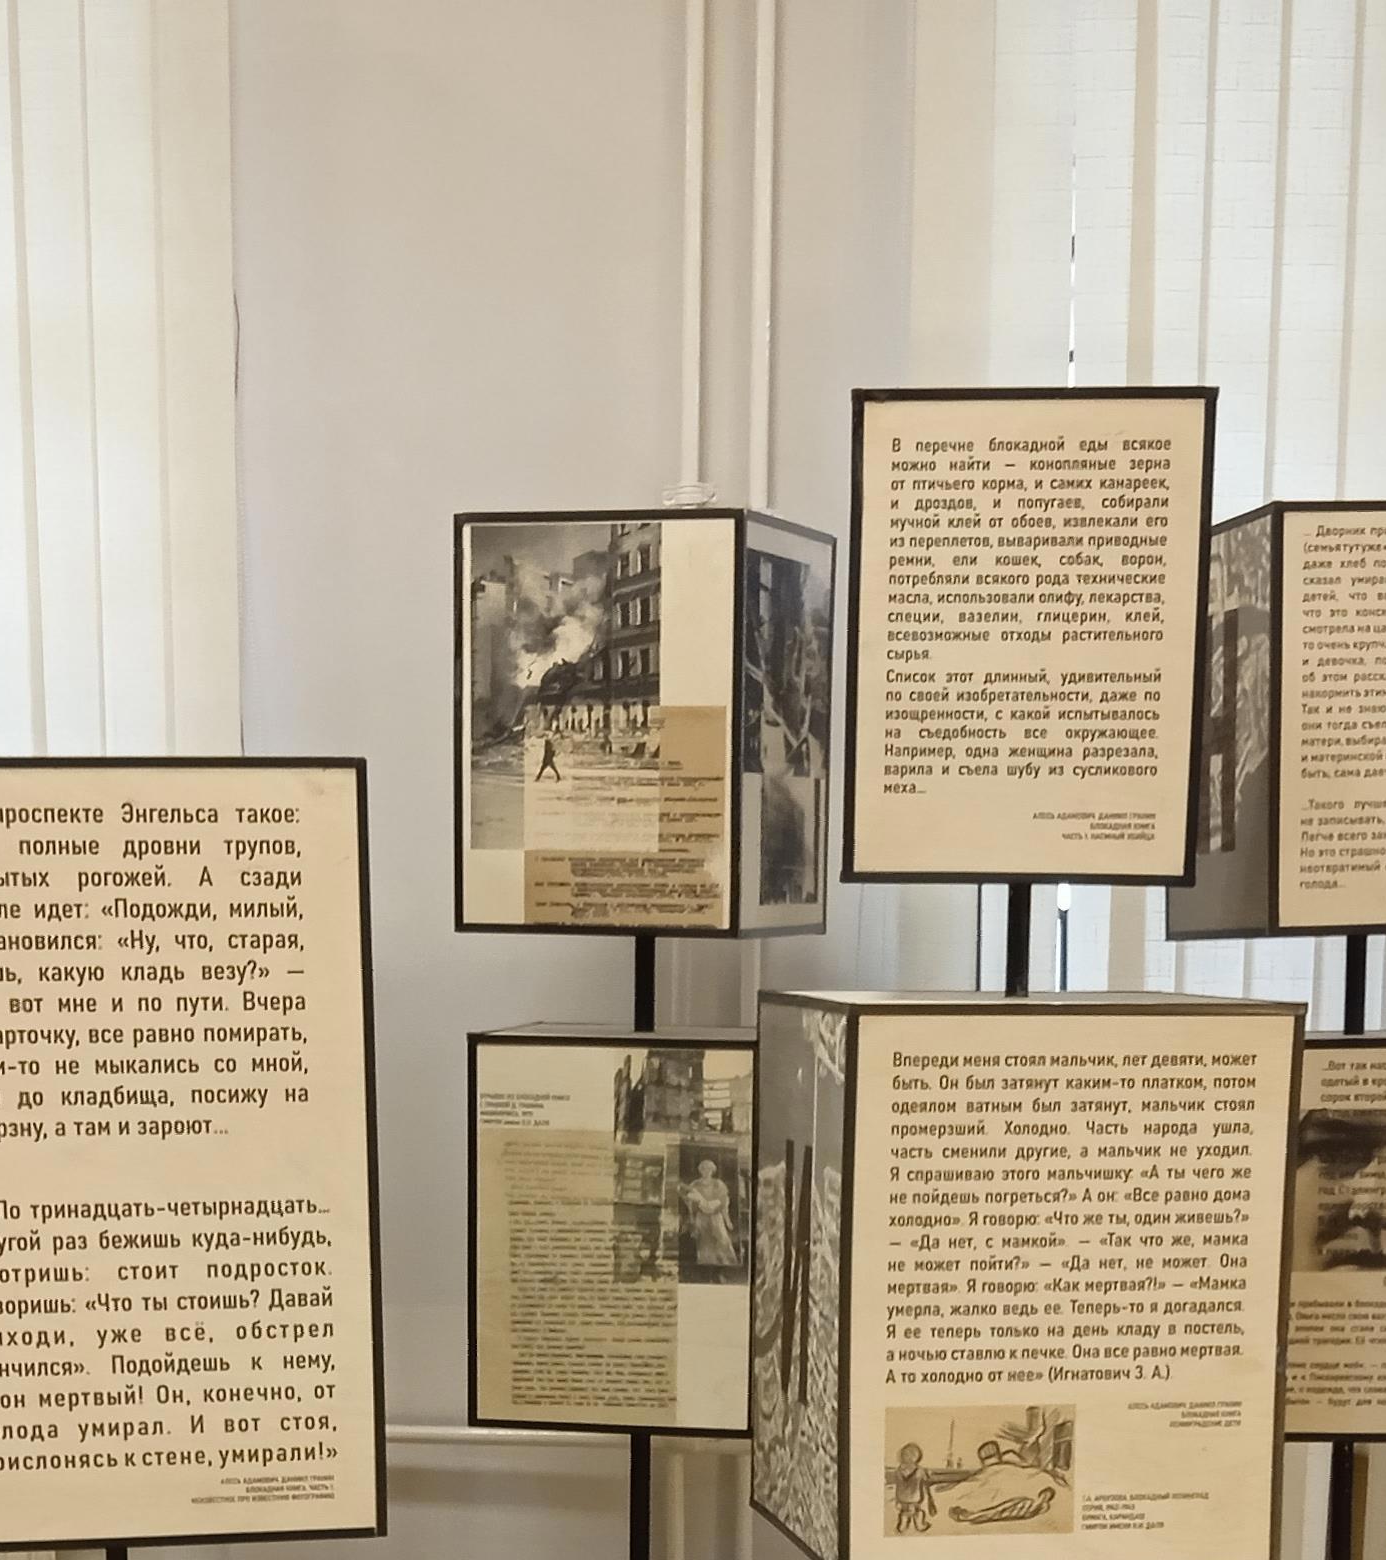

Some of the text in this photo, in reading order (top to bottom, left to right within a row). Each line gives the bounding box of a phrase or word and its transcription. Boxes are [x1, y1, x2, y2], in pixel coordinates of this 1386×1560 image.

[891, 436, 1172, 456] В перечне блокадной еды всякое
[885, 667, 1162, 687] Список этот длинный, удивительный
[120, 801, 218, 824] Энгельса
[234, 806, 300, 824] такое:
[18, 838, 99, 856] полные
[121, 838, 201, 861] дровни
[222, 838, 301, 861] трупов,
[77, 863, 172, 893] рогожей.
[198, 864, 213, 887] А
[239, 869, 302, 890] сзади
[33, 902, 89, 923] идет:
[100, 896, 217, 922] «Подожди,
[228, 901, 303, 921] милый,
[116, 928, 160, 955] «Ну,
[173, 933, 213, 953] что,
[227, 932, 304, 955] старая,
[892, 1050, 1258, 1071] Впереди меня стоял мальчик, лет девяти, может
[938, 1073, 959, 1090] Он
[965, 1073, 995, 1090] был
[1000, 1077, 1060, 1094] затянут
[1064, 1077, 1136, 1090] каким-то
[1140, 1076, 1207, 1091] платком,
[1212, 1076, 1256, 1089] потом
[51, 1234, 87, 1256] раз
[98, 1228, 181, 1250] бежишь
[191, 1224, 332, 1253] куда-нибудь,
[117, 1263, 179, 1281] стоит
[206, 1260, 332, 1283] подросток.
[84, 1291, 132, 1312] «Что
[140, 1295, 168, 1311] ты
[176, 1288, 260, 1310] стоишь?
[267, 1284, 333, 1312] Давай
